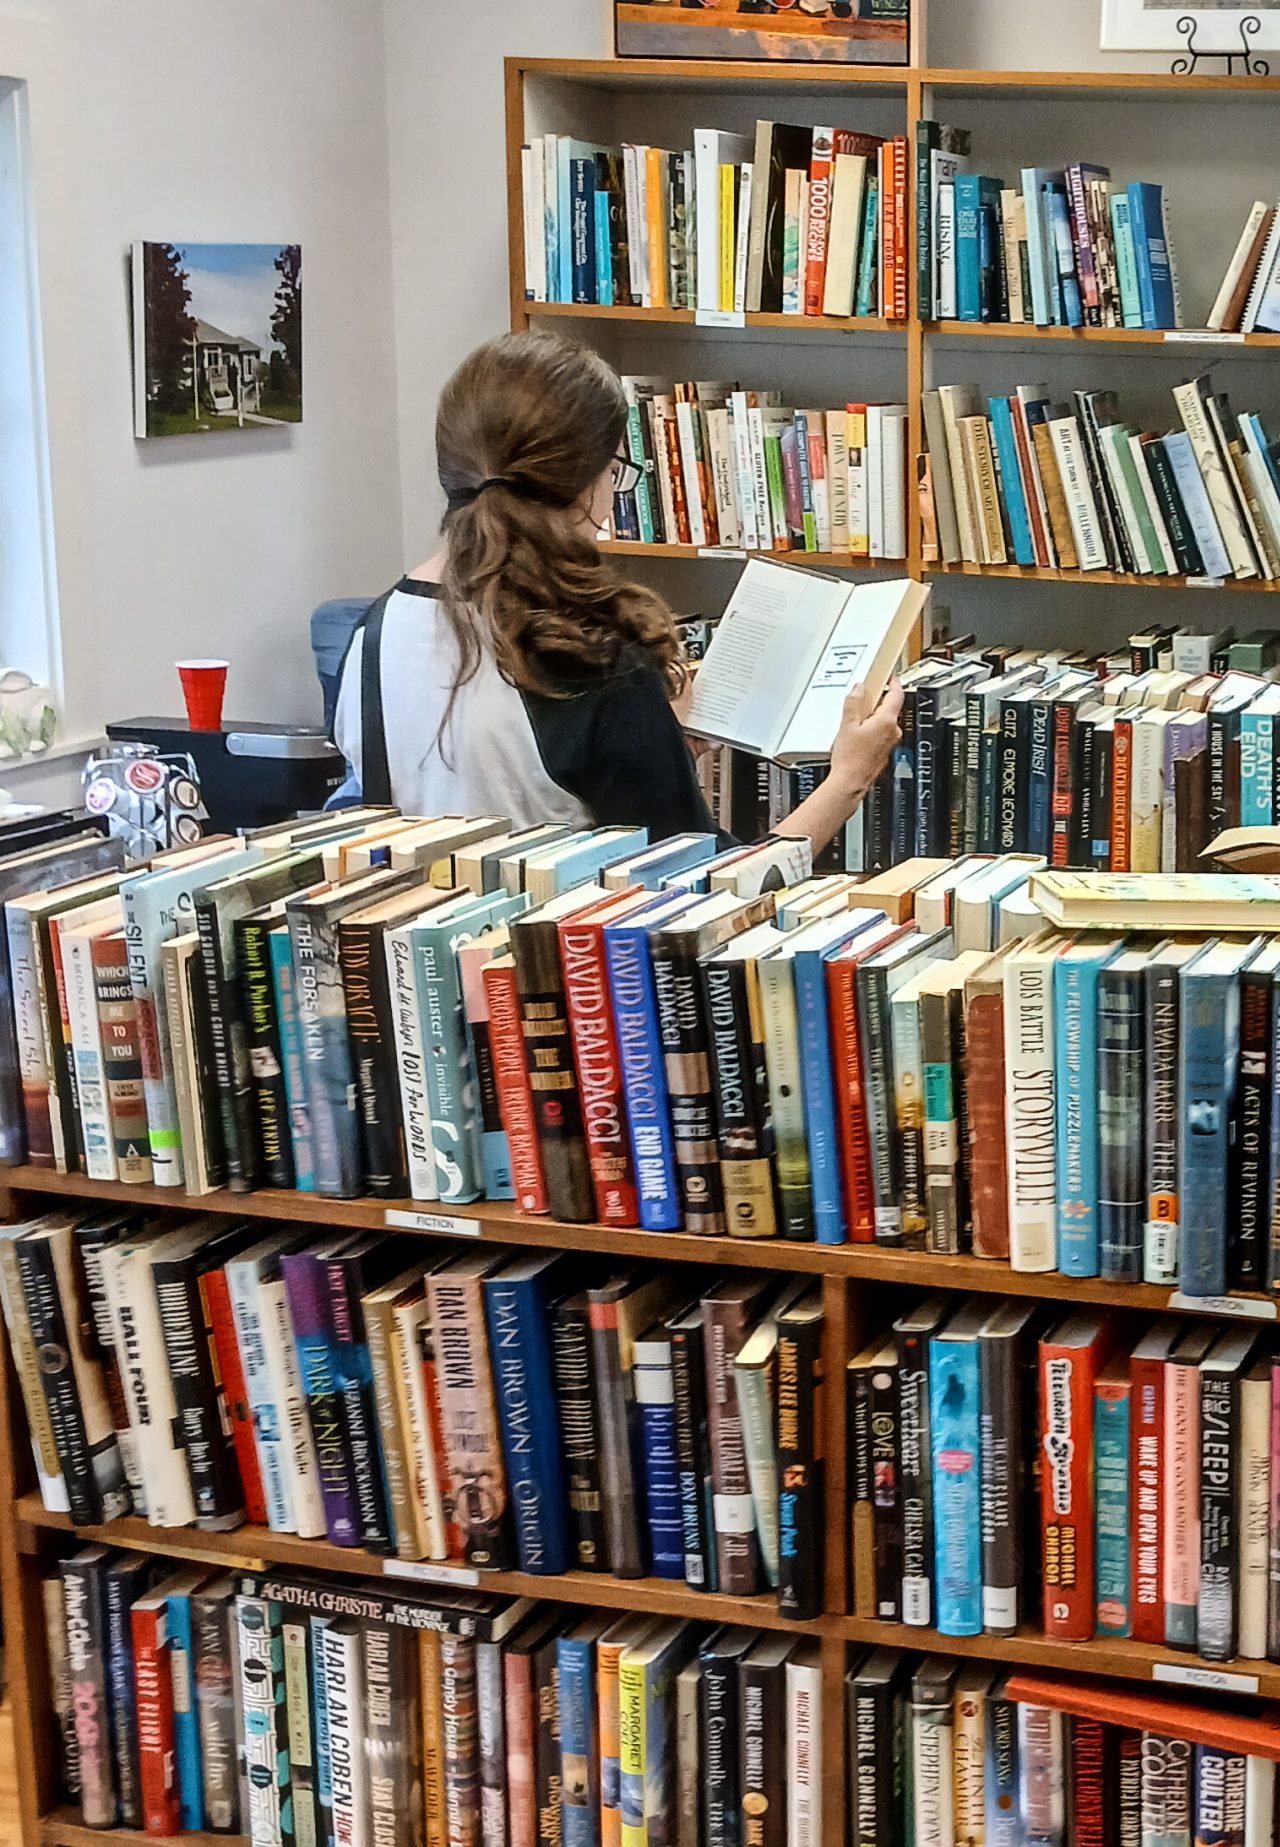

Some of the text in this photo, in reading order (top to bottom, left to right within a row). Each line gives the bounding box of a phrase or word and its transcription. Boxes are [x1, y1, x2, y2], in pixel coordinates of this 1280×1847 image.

[809, 177, 828, 218] 1000
[796, 420, 804, 430] THE
[797, 432, 806, 459] COMPLETE
[1179, 396, 1199, 440] THE ARTIST
[1187, 390, 1206, 443] ANATOMY FOR
[755, 452, 766, 527] GLUTEN FREE Recipes
[800, 460, 808, 477] GUIDE
[803, 486, 811, 509] FASTING
[832, 434, 847, 527] TOWN COUNTRY
[974, 423, 994, 513] THE STORY OF ART
[918, 695, 933, 800] ALL GIRLS
[967, 728, 980, 770] LEFCOURT
[968, 700, 980, 725] PETER
[1032, 707, 1047, 777] DEAD IRISH
[1211, 730, 1221, 755] HOUSE
[757, 762, 769, 802] WHITE
[1001, 708, 1016, 848] GLITZ ELMORE LEONARD
[1211, 769, 1222, 783] THE
[1240, 731, 1256, 778] END
[1256, 719, 1273, 809] DEATH'S
[1114, 756, 1127, 868] DEATH DOESN'T FORGET
[1211, 786, 1223, 801] SKY
[418, 945, 448, 1039] paul auster
[488, 977, 520, 1077] ANXIOUS PEOPLE
[608, 937, 657, 1121] DAVID BALDACCI
[653, 960, 682, 1047] BALDACCI
[673, 975, 698, 1030] DAVID
[1019, 969, 1045, 1055] LOIS BATTLE
[112, 1024, 128, 1039] TO
[563, 932, 622, 1145] DAVID BALDACCI
[707, 969, 745, 1118] DAVID BALDACCI
[435, 1062, 453, 1116] invisible
[634, 1125, 670, 1201] END GAME
[1012, 1070, 1056, 1207] STORYVILLE
[416, 1216, 454, 1229] FICTION
[436, 1287, 465, 1324] DAN
[441, 1328, 476, 1389] BROWN
[491, 1289, 533, 1454] DAN BROWN
[552, 1322, 596, 1460] SANDRA BROWN
[1201, 1414, 1231, 1483] SLEEP
[514, 1479, 544, 1566] ORIGIN
[679, 1471, 700, 1550] DON BRUNS
[1137, 1437, 1158, 1604] WAKE UP AND OPEN YOUR EYES
[1060, 1525, 1077, 1586] MICHAEL
[260, 1583, 383, 1619] AGATHA CHRISTIE
[365, 1629, 393, 1727] HARLAN COBEN
[325, 1638, 354, 1807] HARLAN COBEN
[629, 1695, 642, 1770] MARGARET
[857, 1697, 877, 1838] MICHAEL CONNELLY
[1199, 1755, 1225, 1832] COULTER
[1224, 1757, 1246, 1833] CATHERINE
